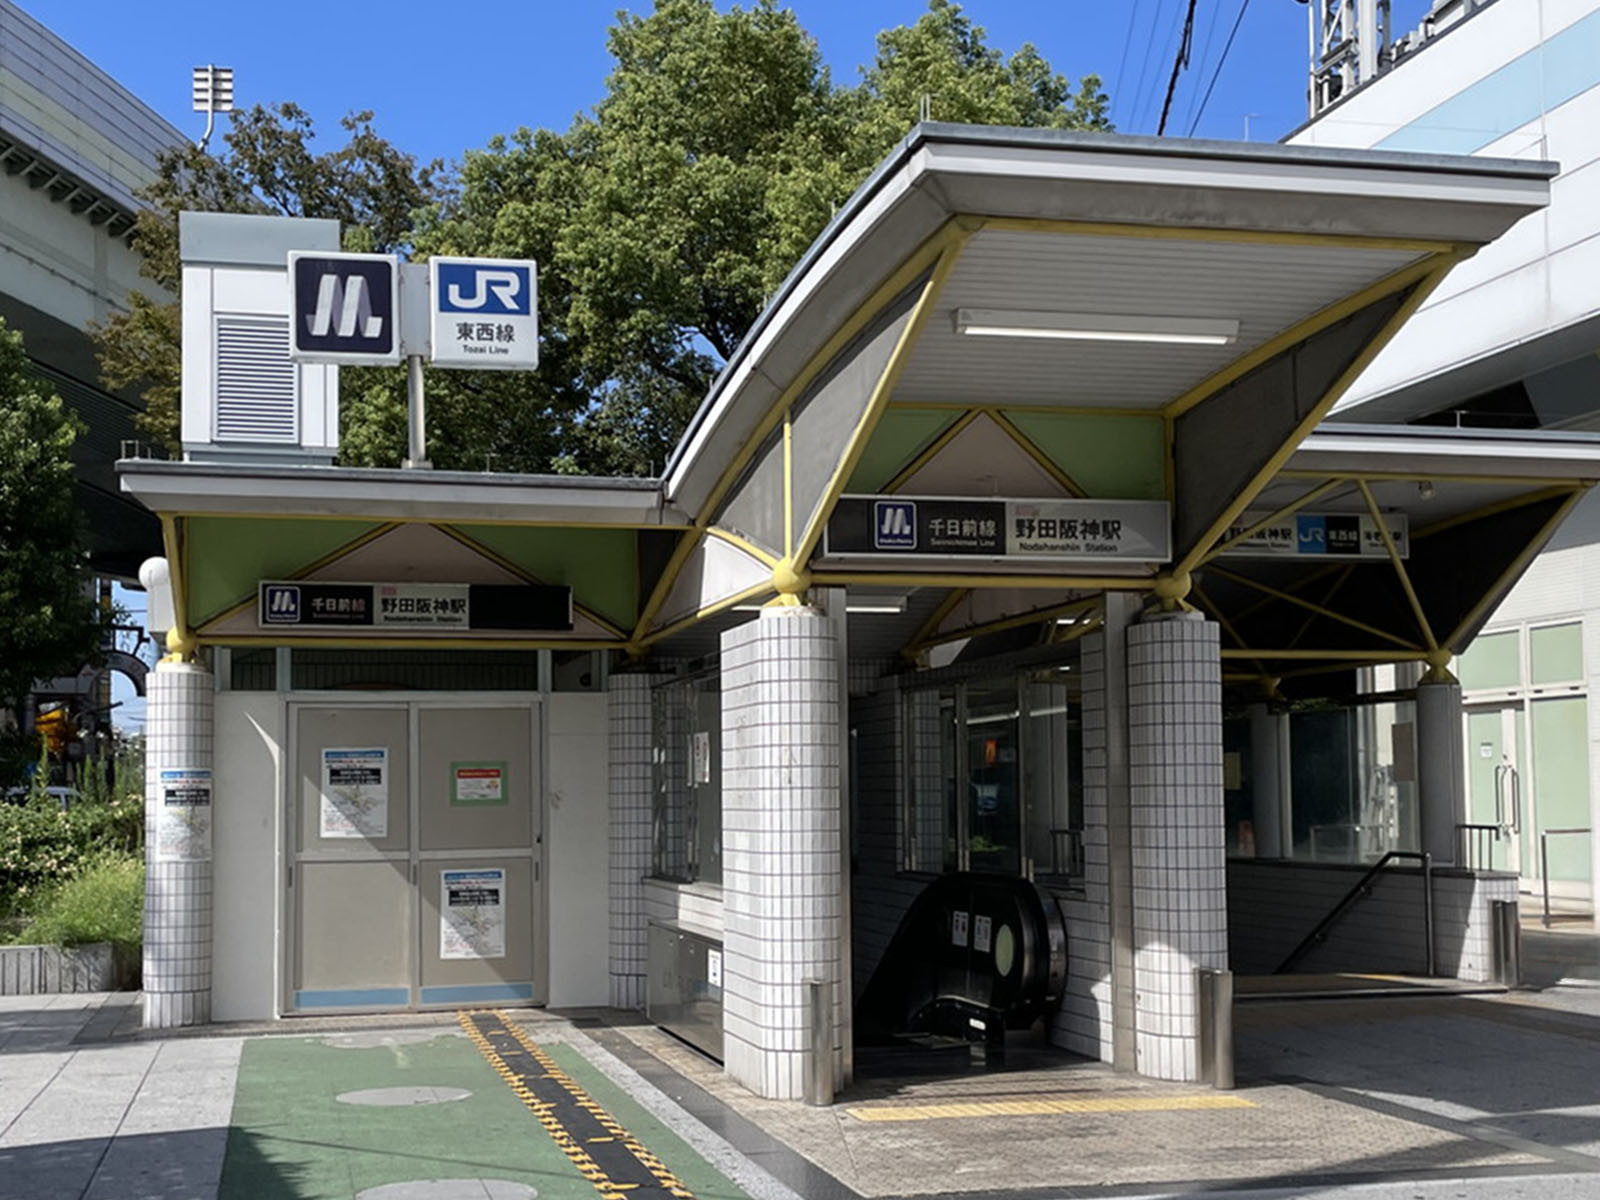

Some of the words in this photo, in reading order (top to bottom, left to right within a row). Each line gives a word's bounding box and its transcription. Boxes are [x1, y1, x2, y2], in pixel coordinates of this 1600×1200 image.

[448, 270, 520, 311] JR
[456, 322, 515, 343] 東西線
[463, 344, 486, 354] Tozai
[489, 345, 509, 355] Line
[928, 518, 996, 537] 千日前線
[1015, 518, 1121, 540] 野田阪神駅
[1299, 527, 1324, 543] JR
[1084, 542, 1118, 552] Station
[311, 597, 366, 612] 千日前線
[381, 598, 466, 613] 野田阪神駅
